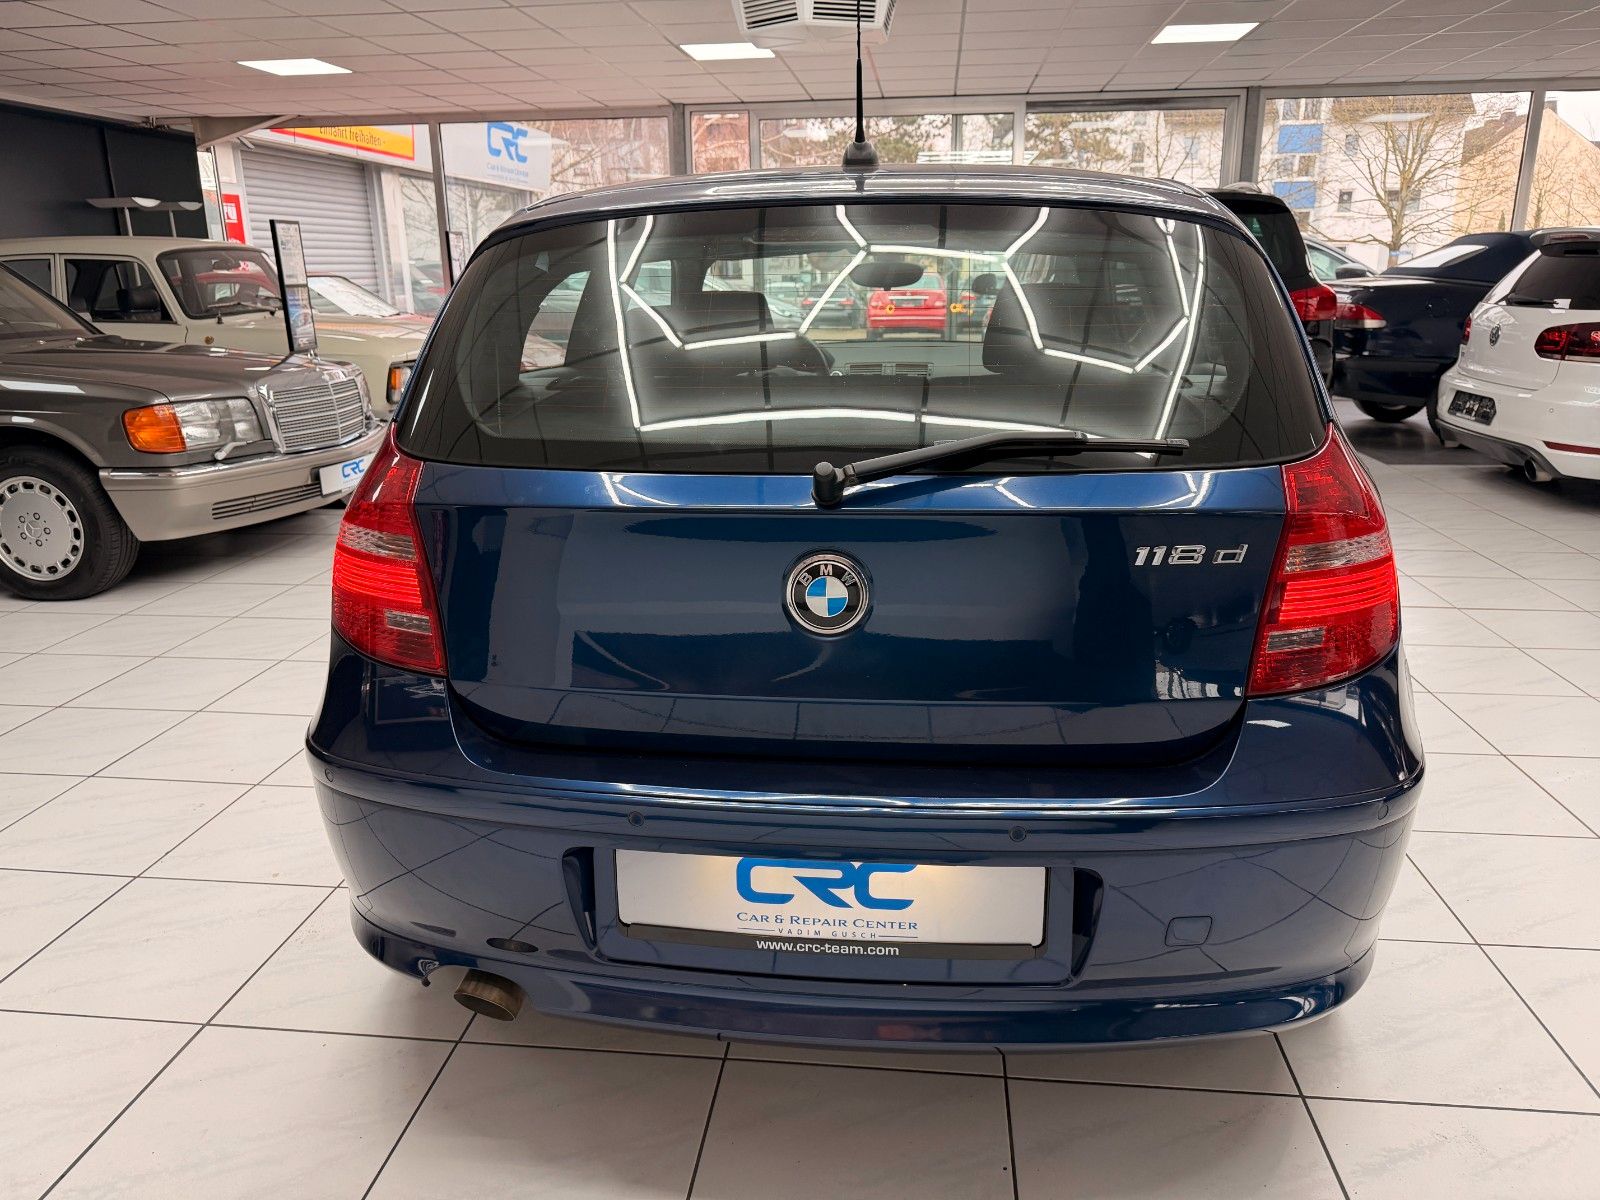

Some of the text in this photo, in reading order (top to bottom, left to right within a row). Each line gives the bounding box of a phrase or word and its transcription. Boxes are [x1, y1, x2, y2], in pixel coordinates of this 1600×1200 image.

[487, 121, 528, 163] CRC
[342, 459, 365, 478] CRC
[1134, 543, 1249, 566] 118 d
[799, 563, 856, 586] BMW
[736, 857, 918, 911] CRC
[736, 911, 918, 930] CAR & REPAIR CENTER
[778, 928, 876, 939] VADIM GUSCH
[756, 940, 900, 956] www.crc-team.com
